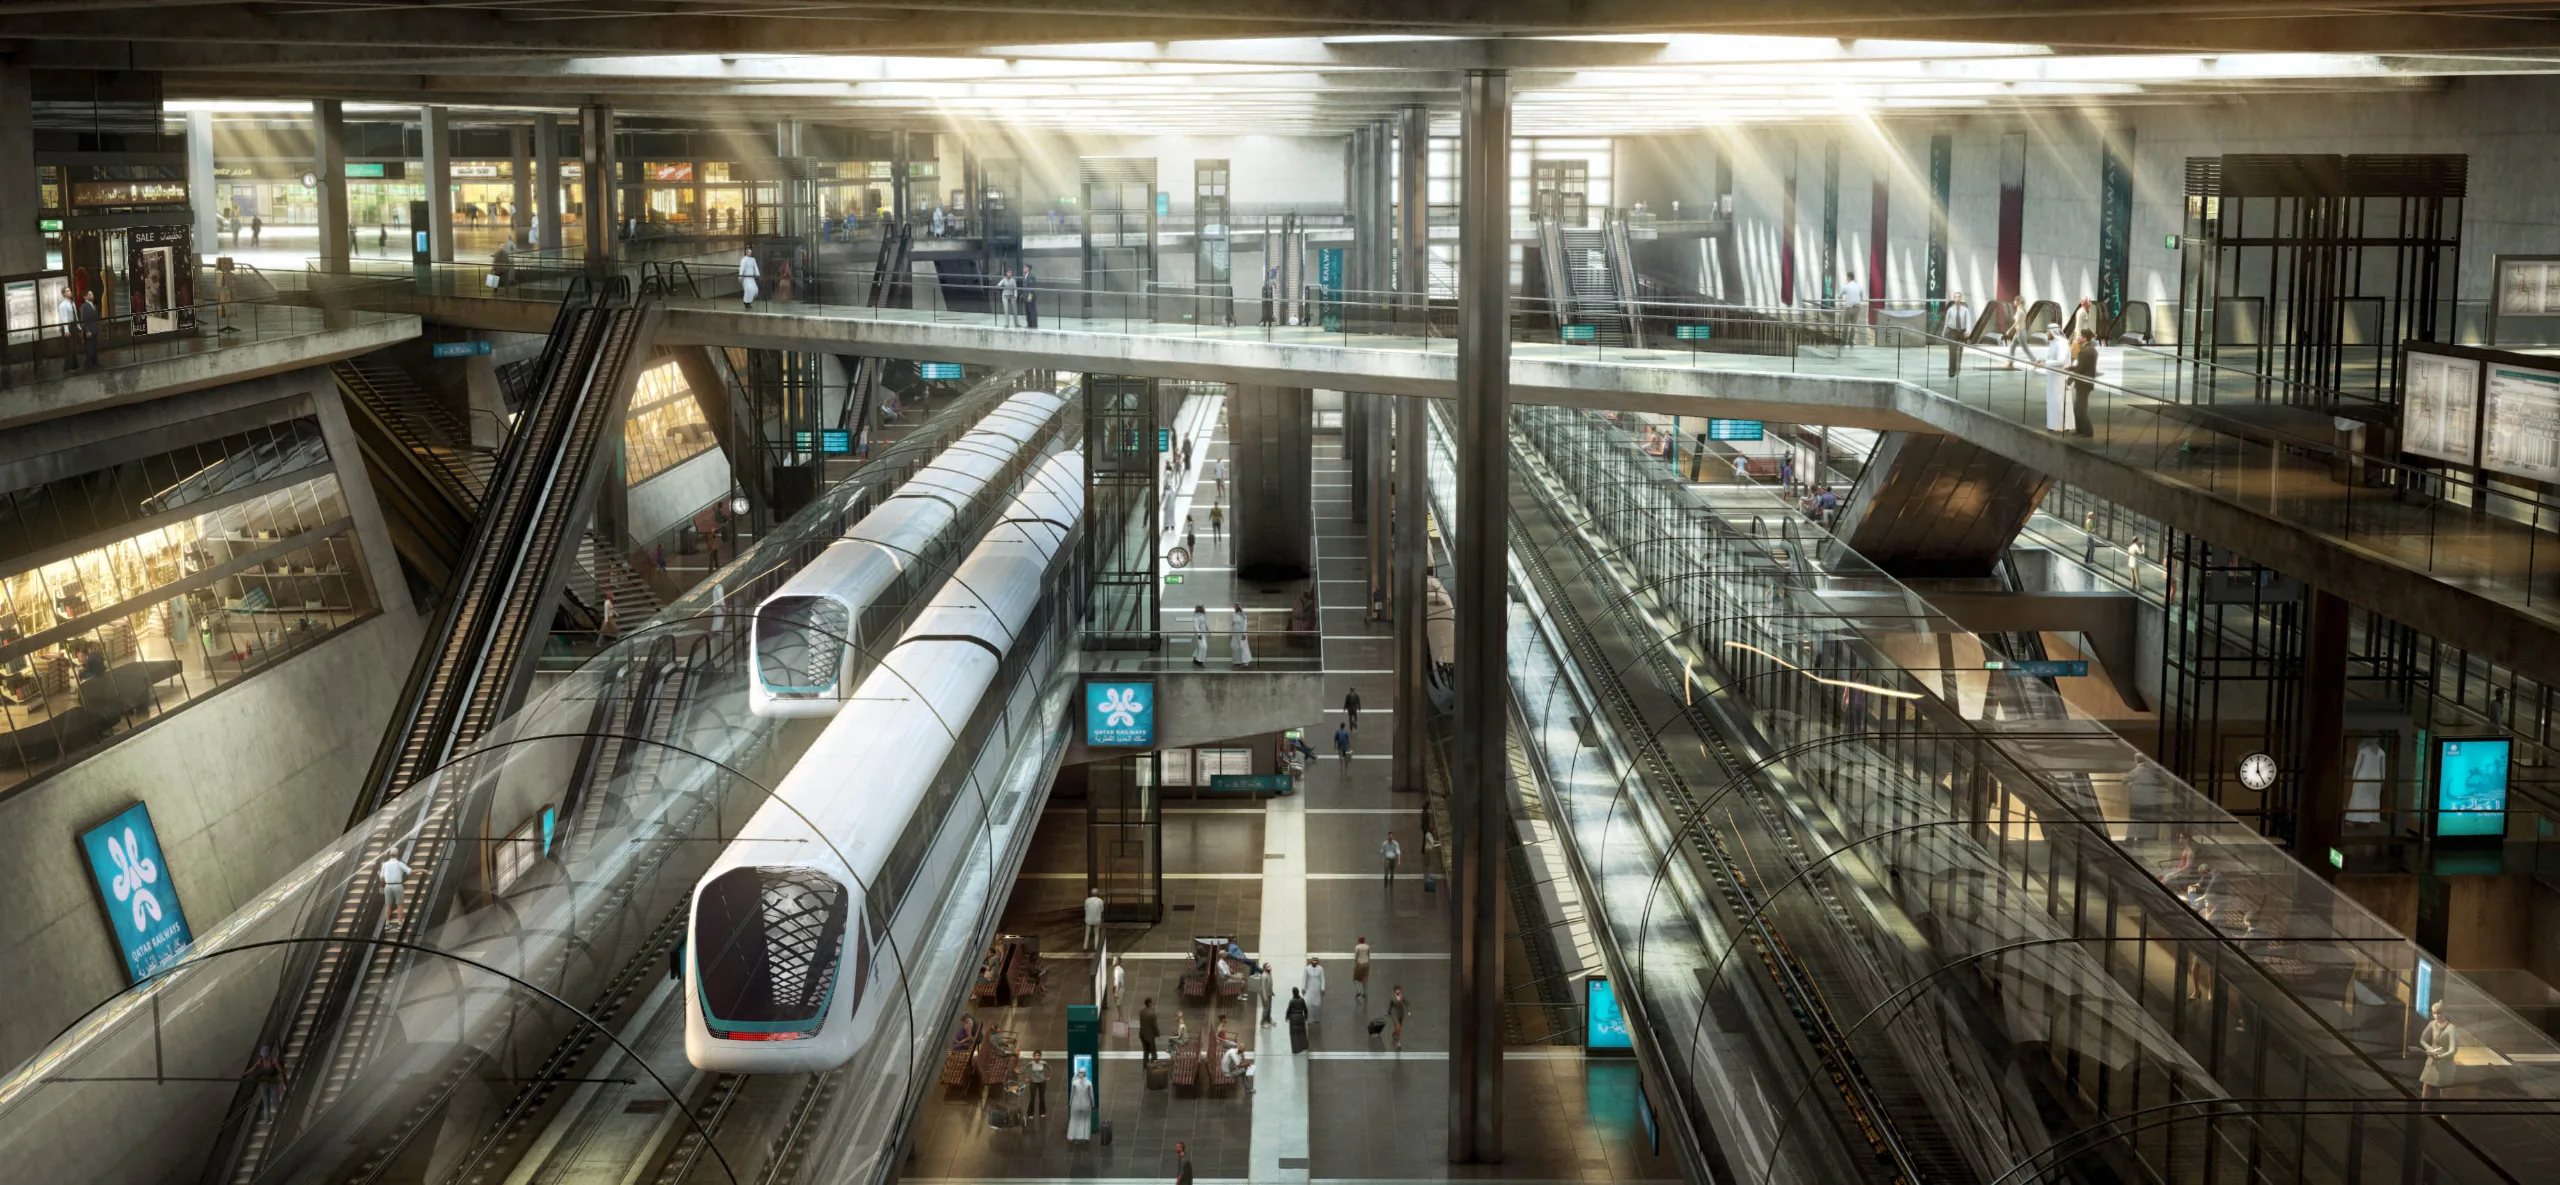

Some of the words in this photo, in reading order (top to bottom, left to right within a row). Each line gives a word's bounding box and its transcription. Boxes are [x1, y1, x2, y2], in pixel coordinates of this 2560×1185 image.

[135, 232, 155, 243] SALE
[2103, 258, 2112, 303] ATAR
[131, 941, 153, 963] QATAR
[151, 921, 181, 949] RAILWAYS
